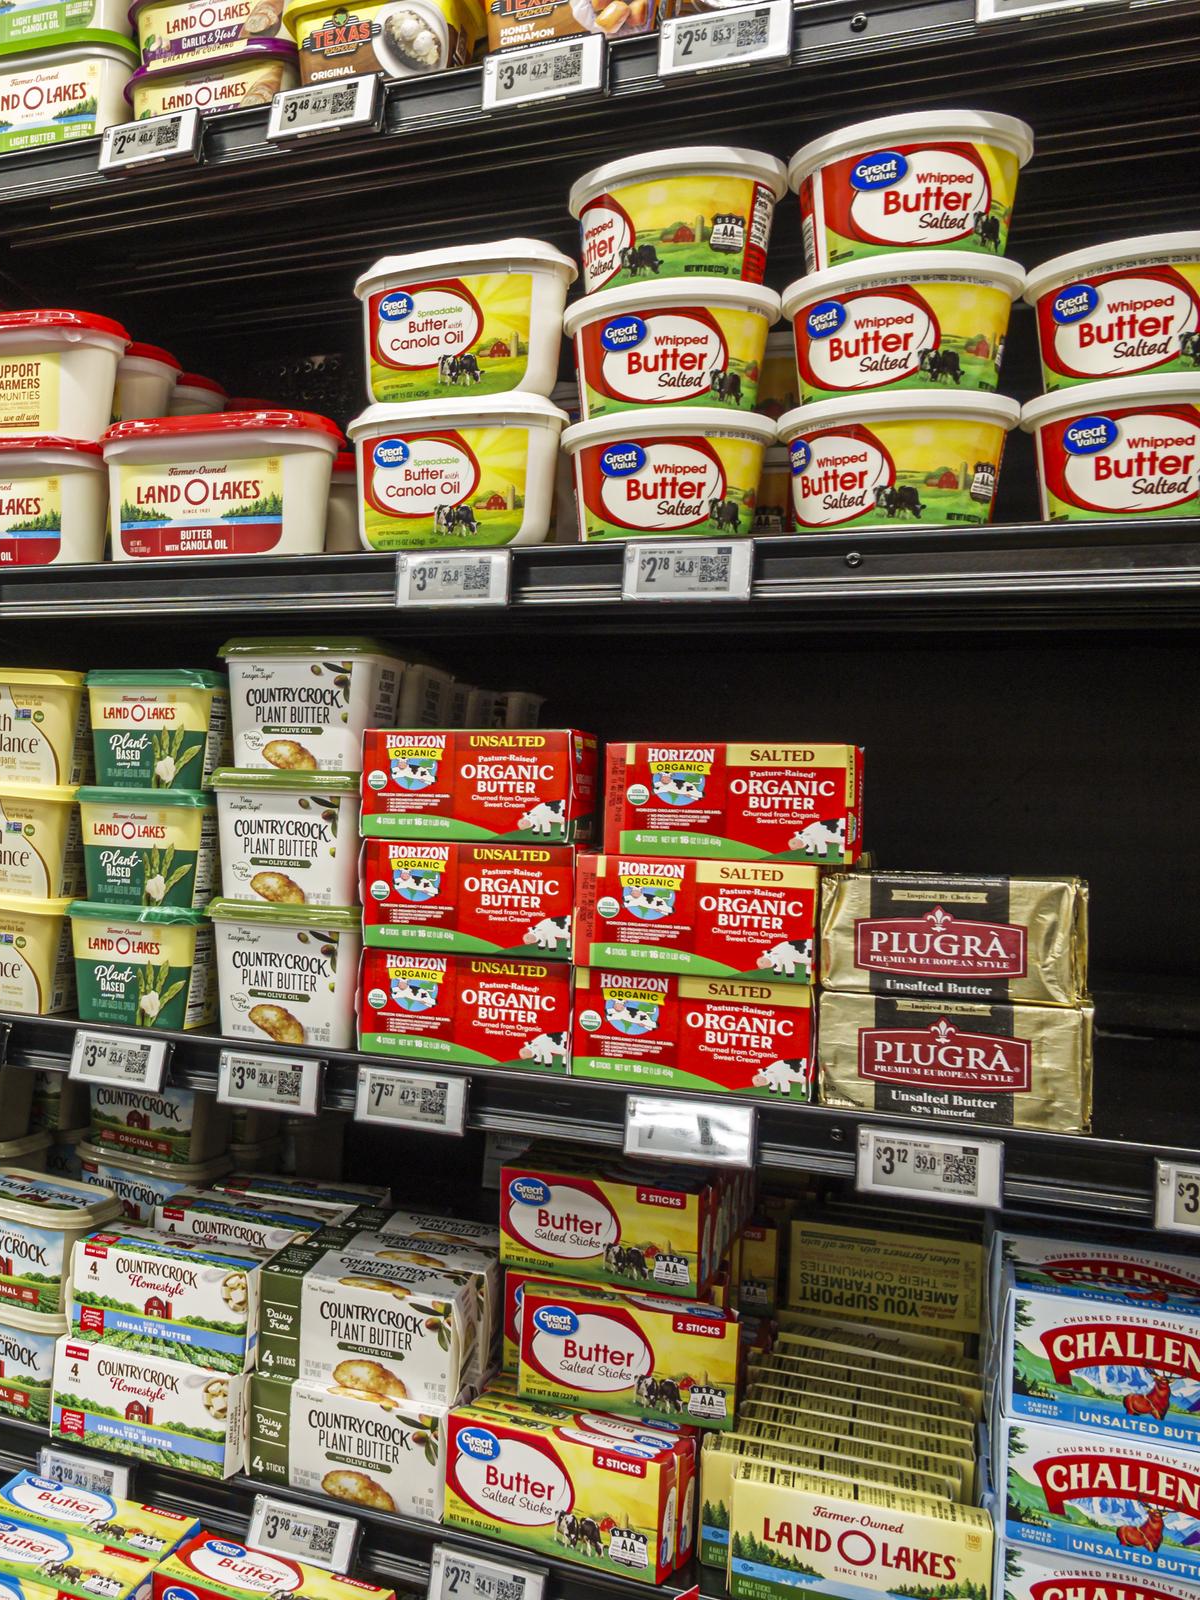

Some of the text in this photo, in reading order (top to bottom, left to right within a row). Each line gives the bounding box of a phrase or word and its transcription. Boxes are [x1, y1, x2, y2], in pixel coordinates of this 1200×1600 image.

[182, 33, 206, 47] GARLIC
[214, 26, 236, 42] Herb
[314, 22, 370, 48] TEXAS
[500, 28, 554, 46] CINNAMON
[501, 23, 536, 36] HONEY
[10, 73, 59, 86] Farmer-Owned
[311, 66, 356, 80] ORIGINAL
[46, 82, 88, 103] LAKES
[381, 299, 407, 311] Great
[388, 306, 407, 316] Value
[417, 306, 462, 317] Spreadable
[408, 318, 462, 332] Butter with
[605, 322, 638, 339] Great
[390, 331, 463, 351] Canola Oil
[612, 333, 638, 345] Value
[654, 335, 708, 347] Whipped
[627, 349, 707, 375] Butter
[658, 372, 704, 389] Salted
[1068, 424, 1106, 442] Great
[1076, 434, 1107, 447] Value
[1127, 434, 1195, 449] Whipped
[168, 465, 226, 477] Farmer-Owned
[1095, 449, 1194, 481] Butter
[137, 484, 180, 504] LAND
[213, 480, 260, 499] LAKES
[1132, 475, 1190, 495] Salted
[181, 529, 212, 540] BUTTER
[181, 540, 212, 551] CANOLA
[214, 539, 228, 550] OIL
[256, 706, 330, 724] PLANT BUTTER
[386, 735, 446, 749] HORIZON
[469, 736, 545, 748] UNSALTED
[116, 746, 140, 760] BASED
[394, 750, 437, 758] ORGANIC
[461, 763, 554, 781] ORGANIC
[477, 780, 536, 794] BUTTER
[514, 795, 540, 804] Organic
[874, 1041, 1014, 1073] PLUGRÀ
[874, 1065, 1013, 1083] PREMIUM EUROPEAN STYLE
[891, 1090, 997, 1109] Unsalted Butter
[910, 1106, 975, 1118] 82% Butterfat
[129, 1274, 184, 1296] Homestyle
[267, 1308, 293, 1323] Dairy
[1064, 1315, 1184, 1331] CHURNED FRESH DAILY
[270, 1319, 290, 1331] Free
[262, 1350, 296, 1367] 4 STICKS
[1028, 1402, 1058, 1410] FARMER
[1028, 1407, 1058, 1416] OWNED
[1080, 1411, 1159, 1434] UNSALTED
[462, 1433, 493, 1449] Great
[469, 1444, 493, 1455] Value
[597, 1456, 641, 1474] 2 STICKS
[486, 1465, 554, 1500] Butter
[481, 1487, 552, 1515] Salted Sticks
[812, 1505, 904, 1535] Farmer-Owned
[483, 1523, 501, 1533] (227g)
[621, 1540, 635, 1553] AA
[764, 1518, 831, 1552] LAND
[882, 1546, 957, 1579] LAKES
[834, 1566, 878, 1580] SINCE 1921
